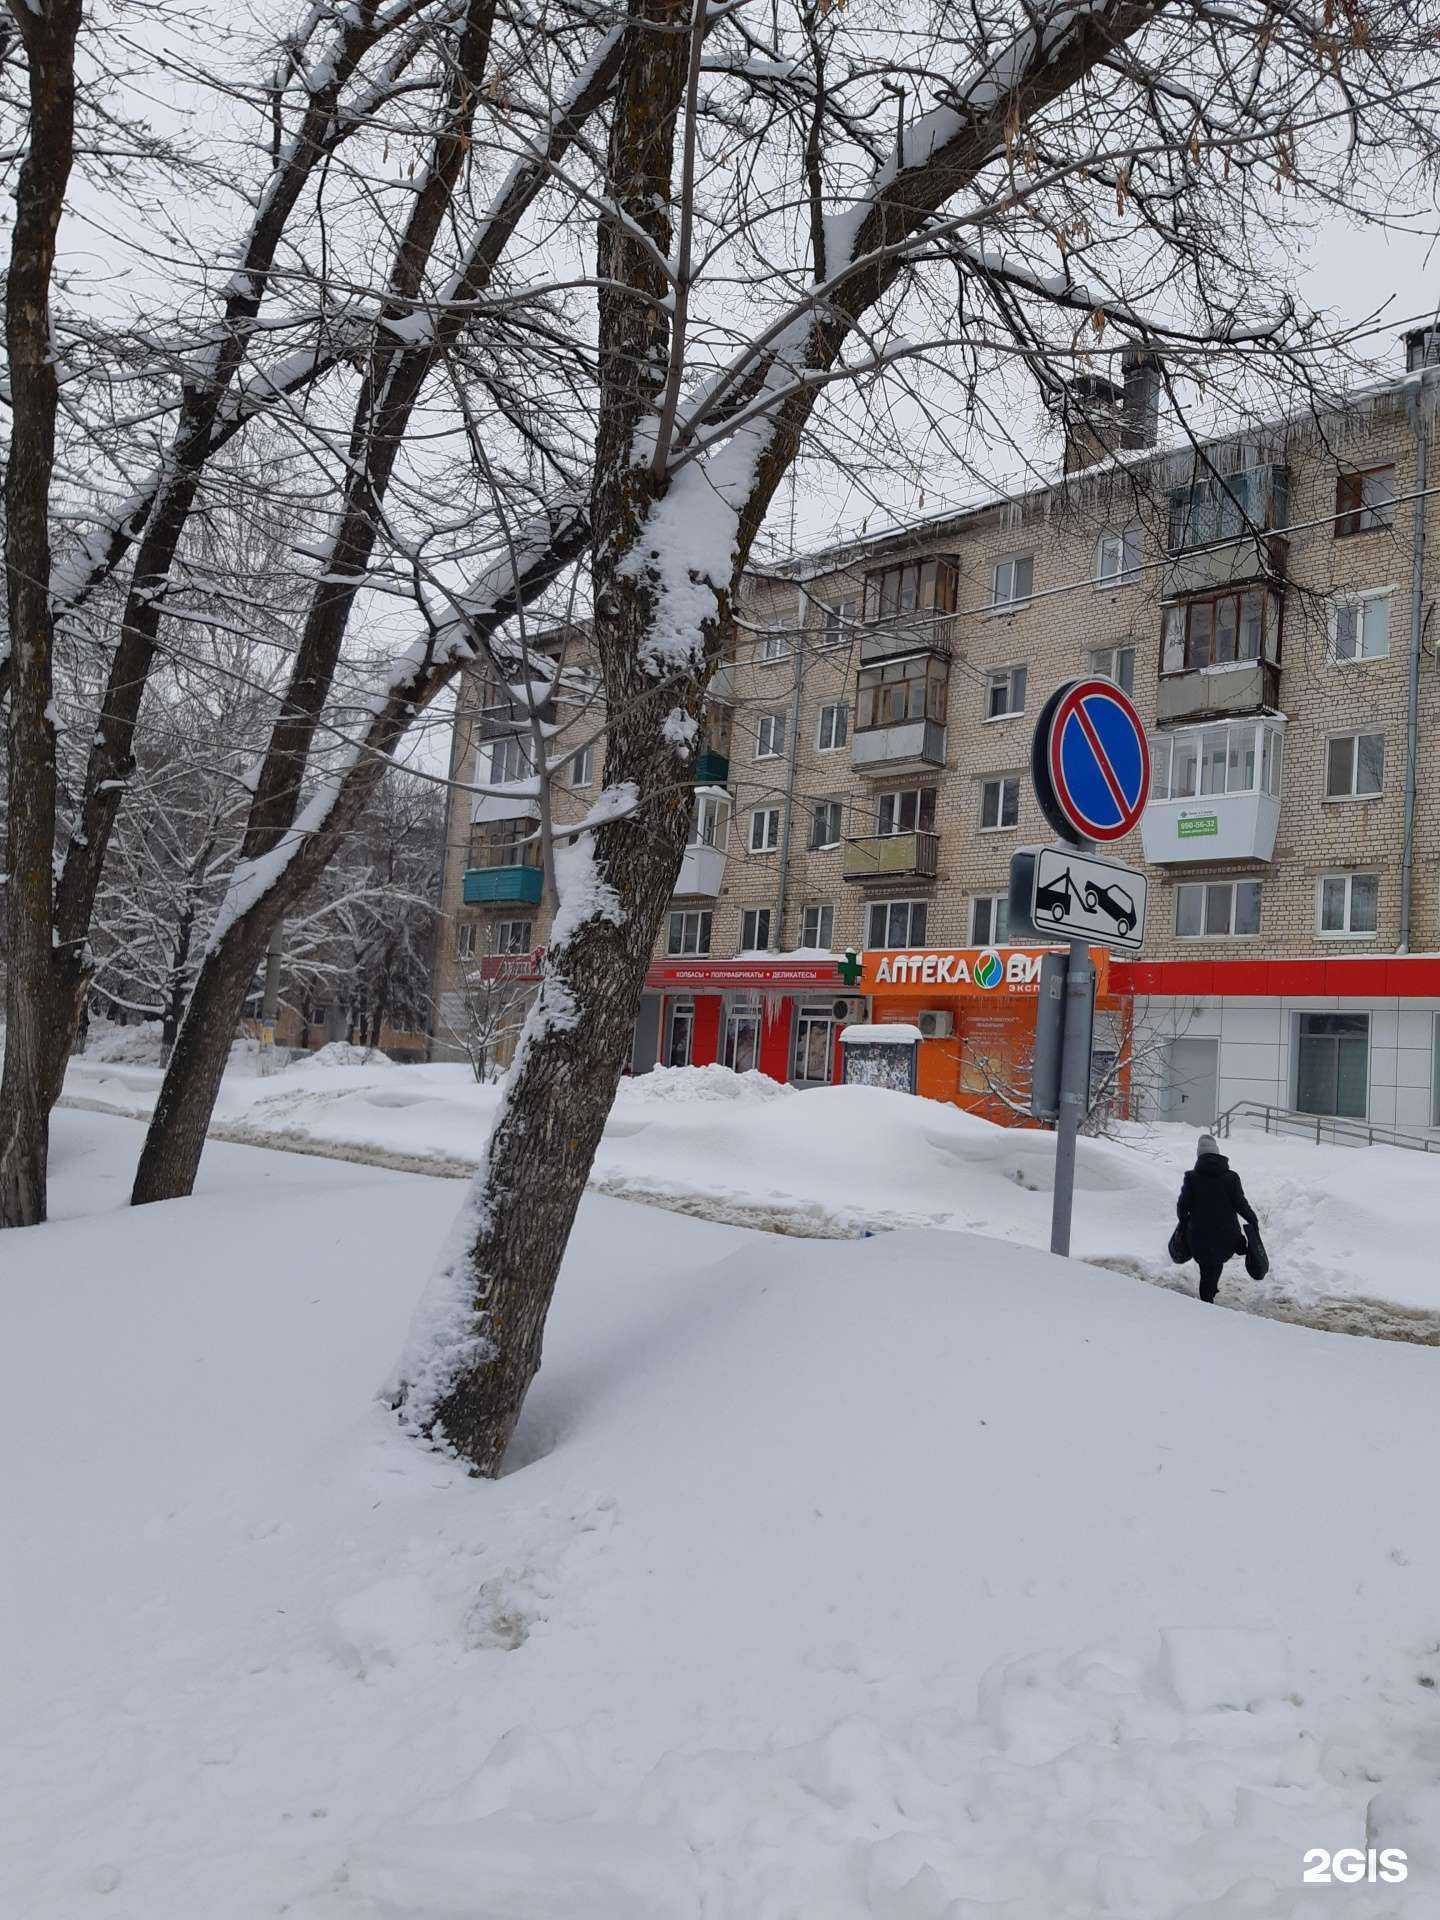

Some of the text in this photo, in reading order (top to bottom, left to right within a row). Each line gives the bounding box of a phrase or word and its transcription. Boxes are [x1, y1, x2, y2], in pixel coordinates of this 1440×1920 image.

[676, 971, 817, 979] КОЛБАСЫ ПОЛУФАБРИКАТЫ ДЕЛИКАТЕСЫ
[875, 957, 971, 984] АПТЕКА
